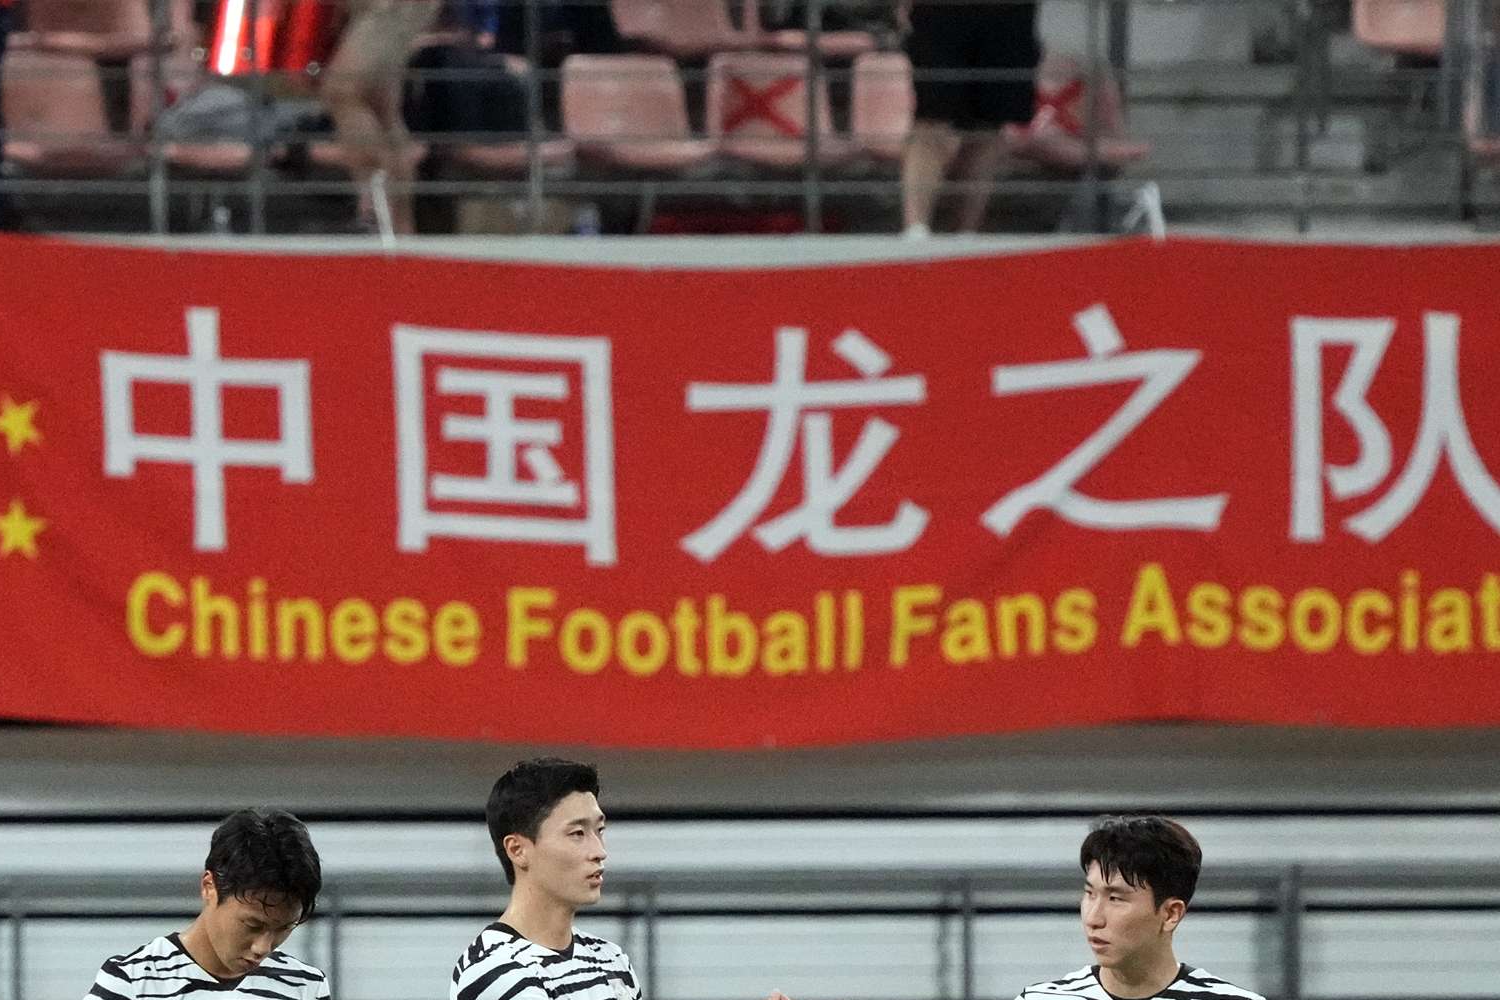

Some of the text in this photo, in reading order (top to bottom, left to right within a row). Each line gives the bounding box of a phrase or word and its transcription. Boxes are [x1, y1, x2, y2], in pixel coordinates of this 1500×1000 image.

[100, 302, 1500, 566] 中国龙之队
[127, 571, 480, 667] Chinese
[506, 586, 862, 678] Football
[891, 585, 1100, 667] Fans
